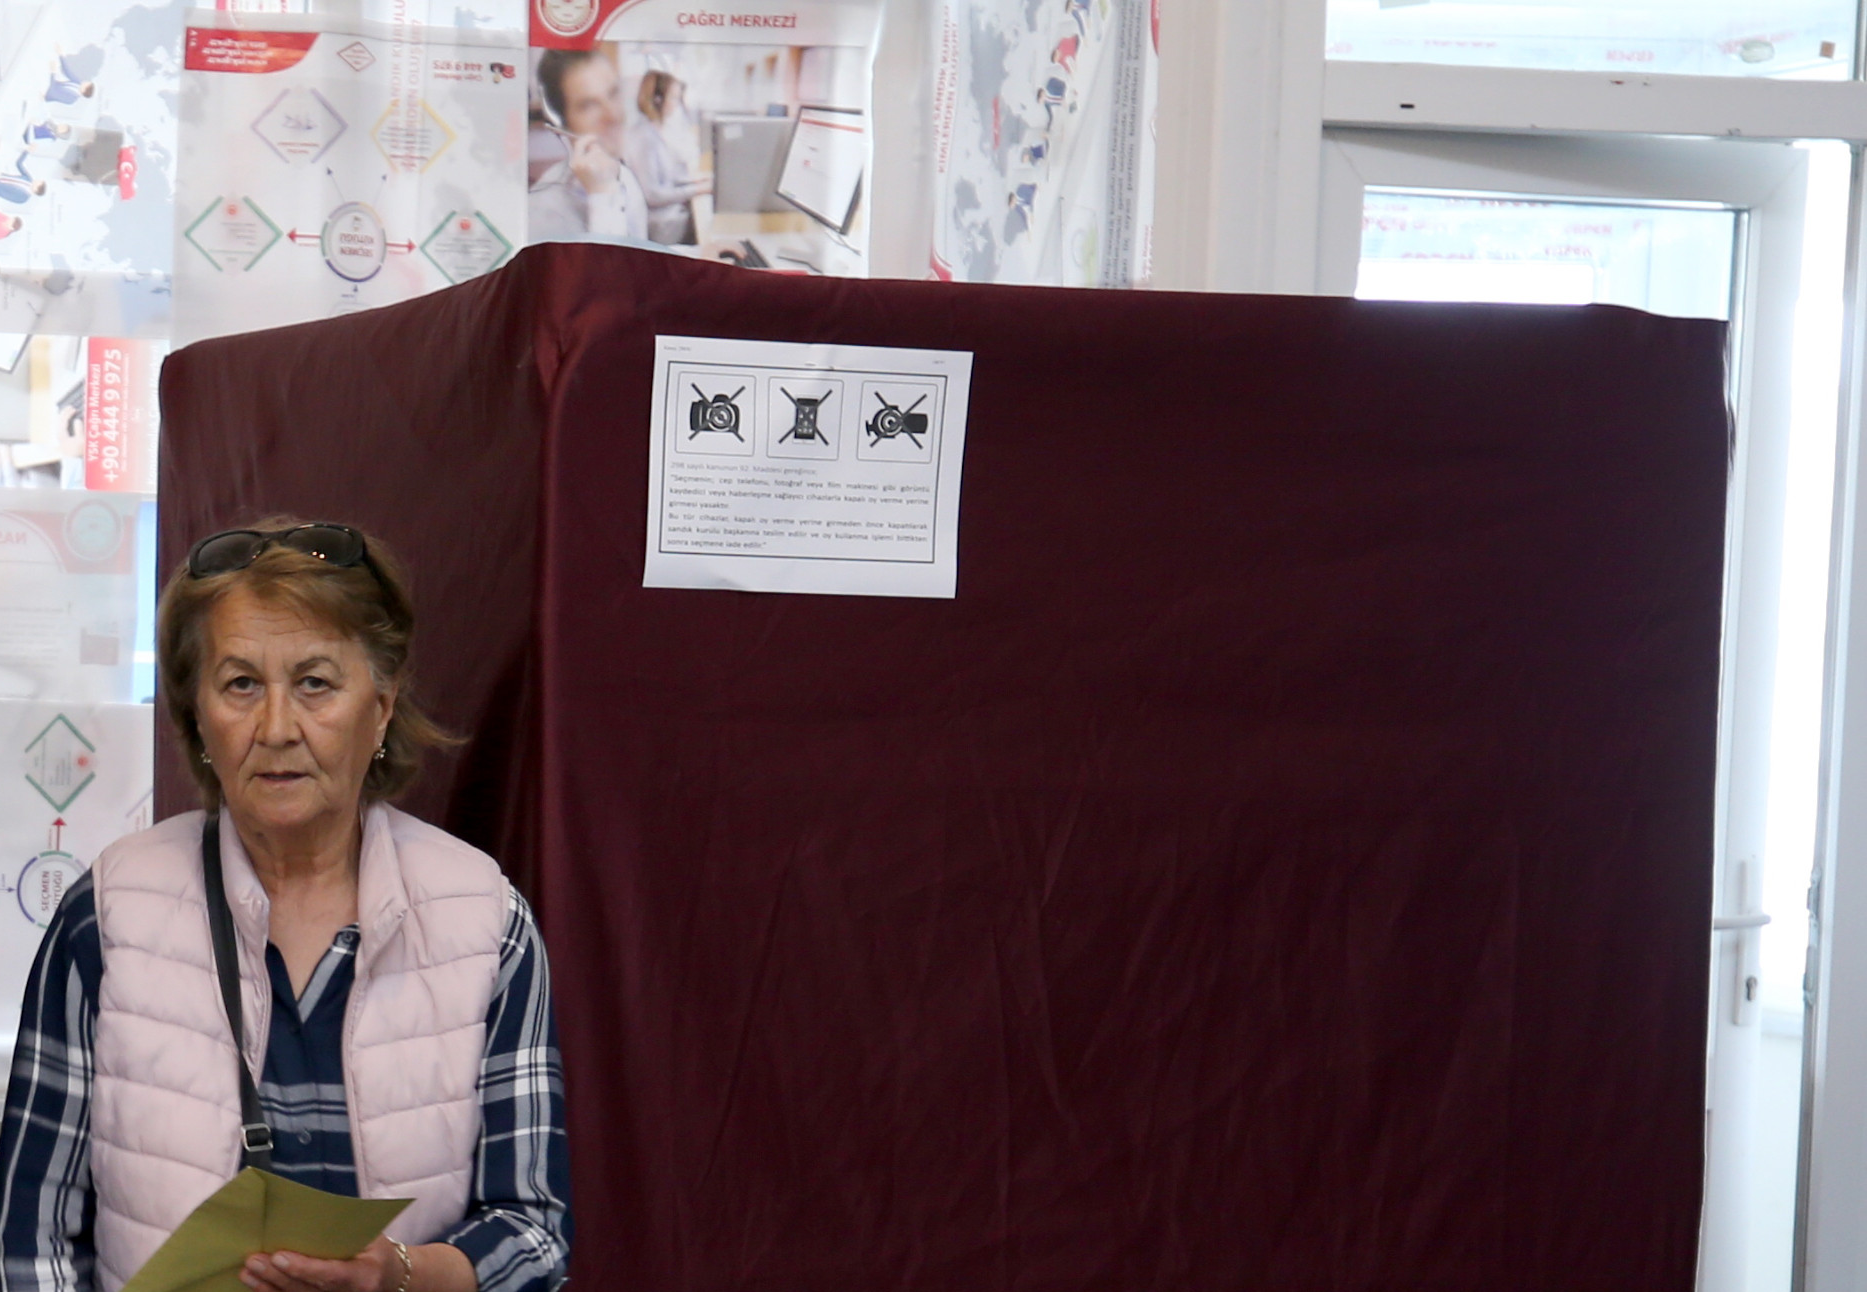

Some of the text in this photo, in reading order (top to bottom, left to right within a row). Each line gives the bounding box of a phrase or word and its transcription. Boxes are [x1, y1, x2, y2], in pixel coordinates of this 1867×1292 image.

[678, 10, 796, 28] ÇAĞRI MERKEZİ
[88, 364, 102, 462] YSK Çağrı Merkezi
[102, 348, 122, 482] +90 444 9 975
[41, 871, 51, 912] SEÇMEN
[53, 870, 63, 910] ÜTÜĞÜ
